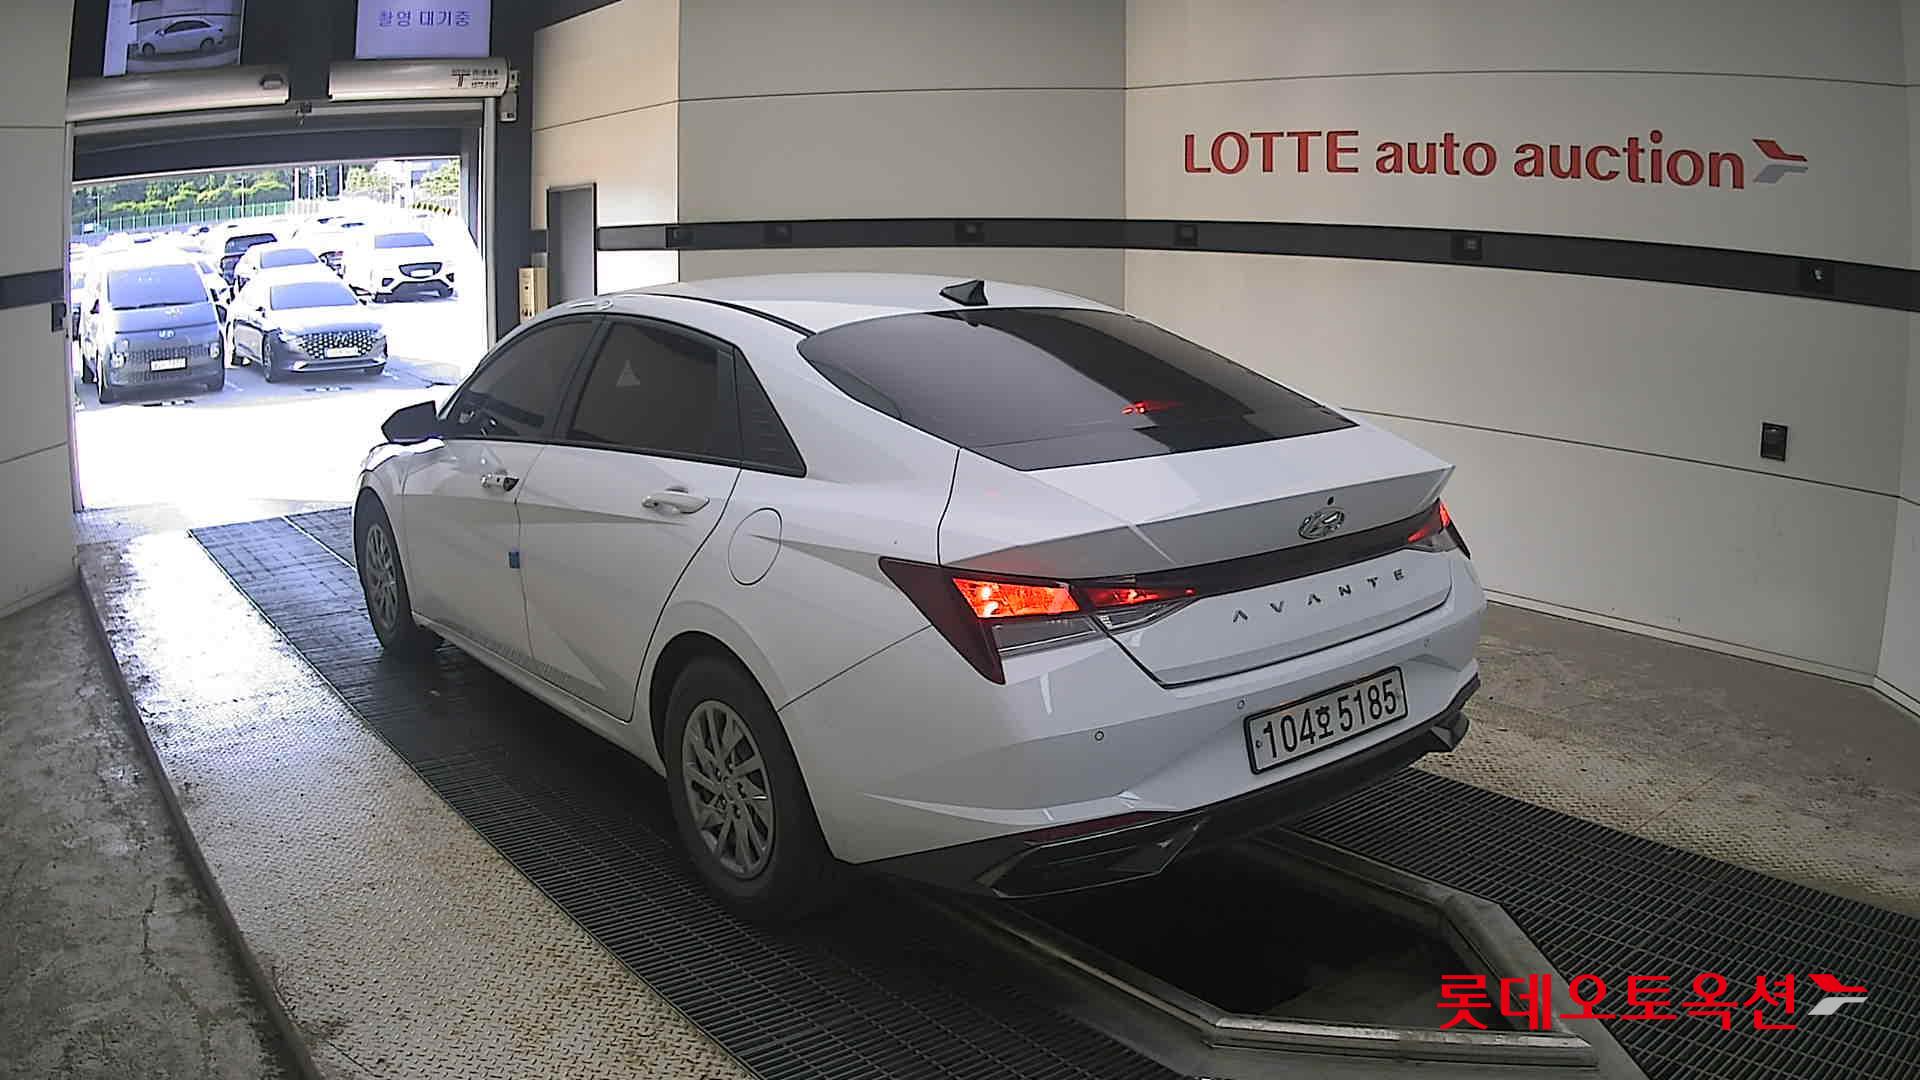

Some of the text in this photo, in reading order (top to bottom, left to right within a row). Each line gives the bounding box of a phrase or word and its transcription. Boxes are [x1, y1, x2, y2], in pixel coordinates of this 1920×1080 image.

[419, 10, 472, 27] 대기중
[1184, 130, 1745, 189] LOTTE auto auction
[1232, 568, 1405, 623] AVANTE
